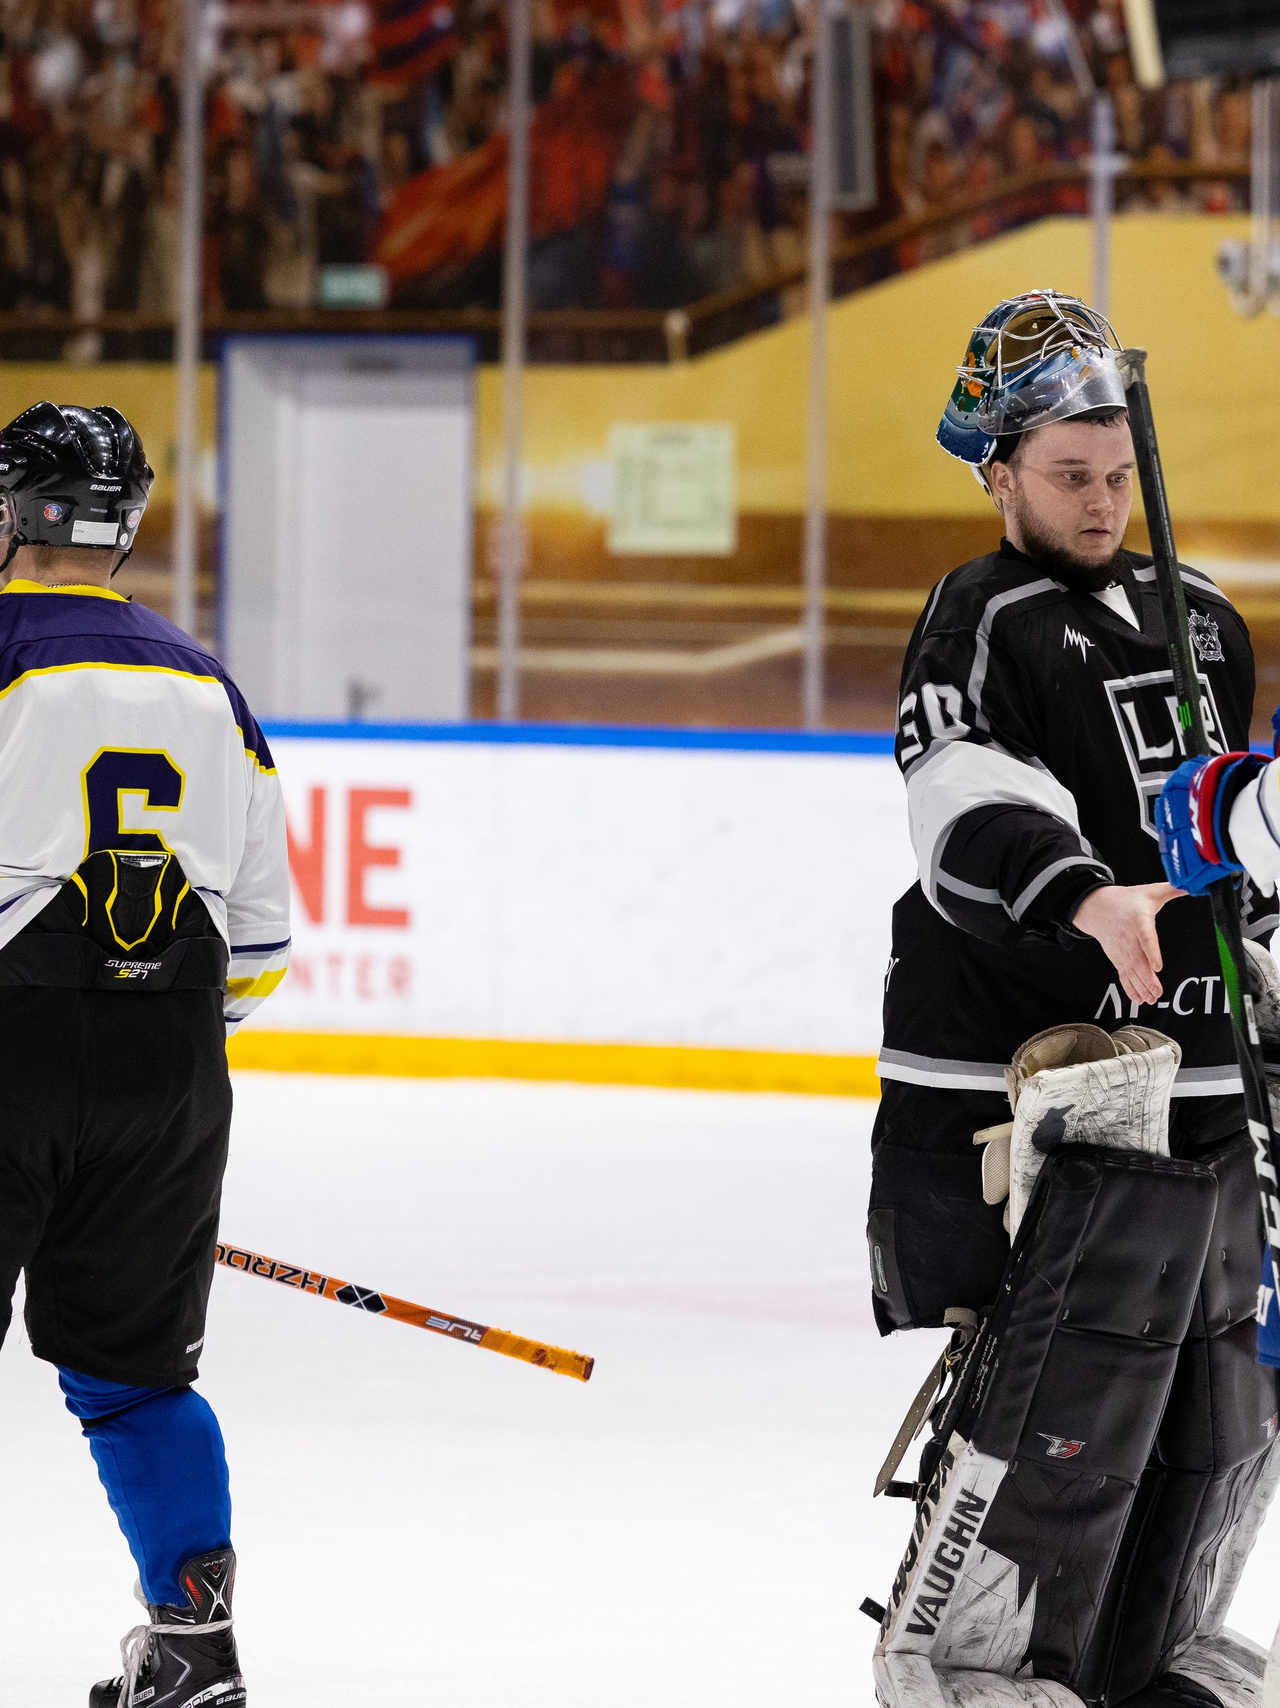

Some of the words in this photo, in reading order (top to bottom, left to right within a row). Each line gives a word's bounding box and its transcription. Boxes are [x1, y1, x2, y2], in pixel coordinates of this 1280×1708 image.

[90, 484, 122, 492] BAUER
[105, 959, 162, 970] SUPREME
[114, 968, 149, 980] S27
[425, 1315, 482, 1342] RUE
[905, 1488, 987, 1635] VAUGHN
